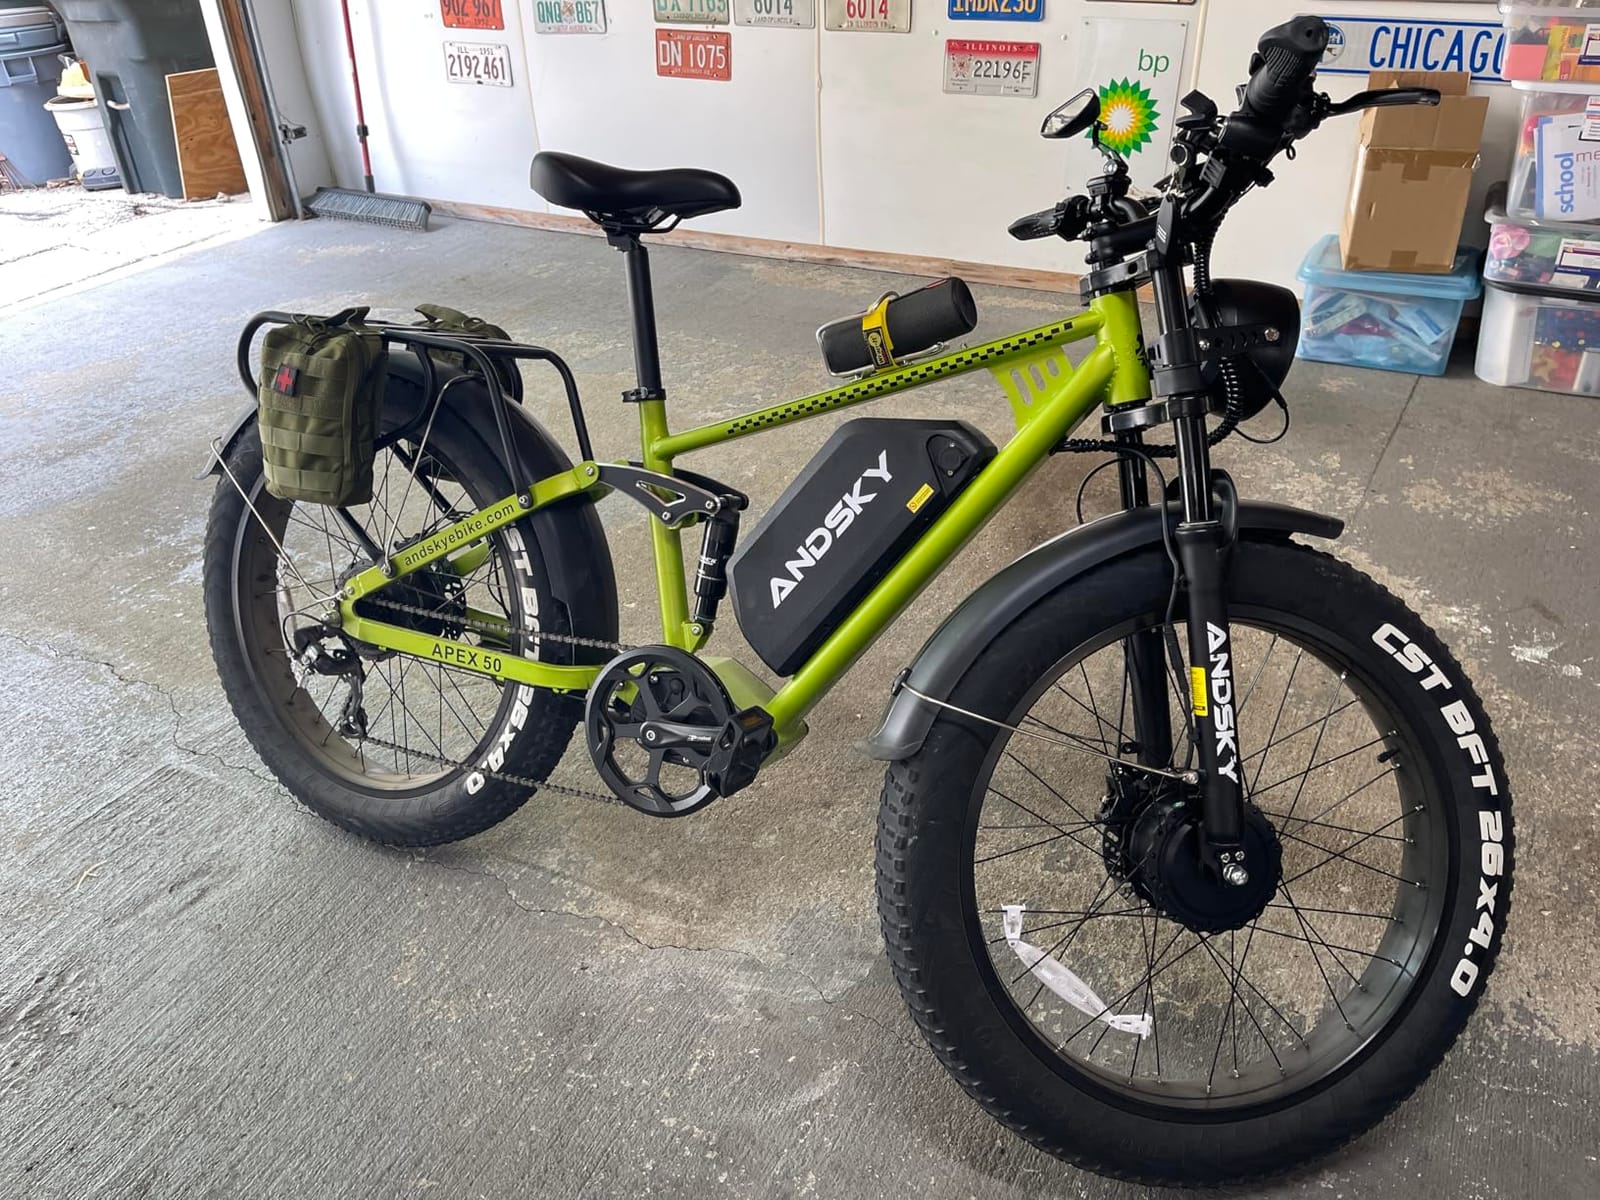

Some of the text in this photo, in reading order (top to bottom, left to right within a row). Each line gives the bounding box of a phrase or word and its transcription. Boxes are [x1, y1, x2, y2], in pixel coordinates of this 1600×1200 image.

[575, 1, 599, 24] 867
[658, 40, 726, 69] DN 1075
[965, 43, 1018, 52] ILLINOIS
[1138, 48, 1170, 78] bp
[974, 60, 1021, 79] 22196
[1553, 152, 1575, 213] school
[404, 503, 515, 566] andskyebike.com
[503, 523, 534, 577] ST
[770, 449, 893, 610] ANDSKY
[431, 643, 502, 673] APEX 50
[1206, 621, 1240, 784] ANDSKY
[1371, 623, 1453, 691] CST
[1440, 699, 1499, 796] BFT
